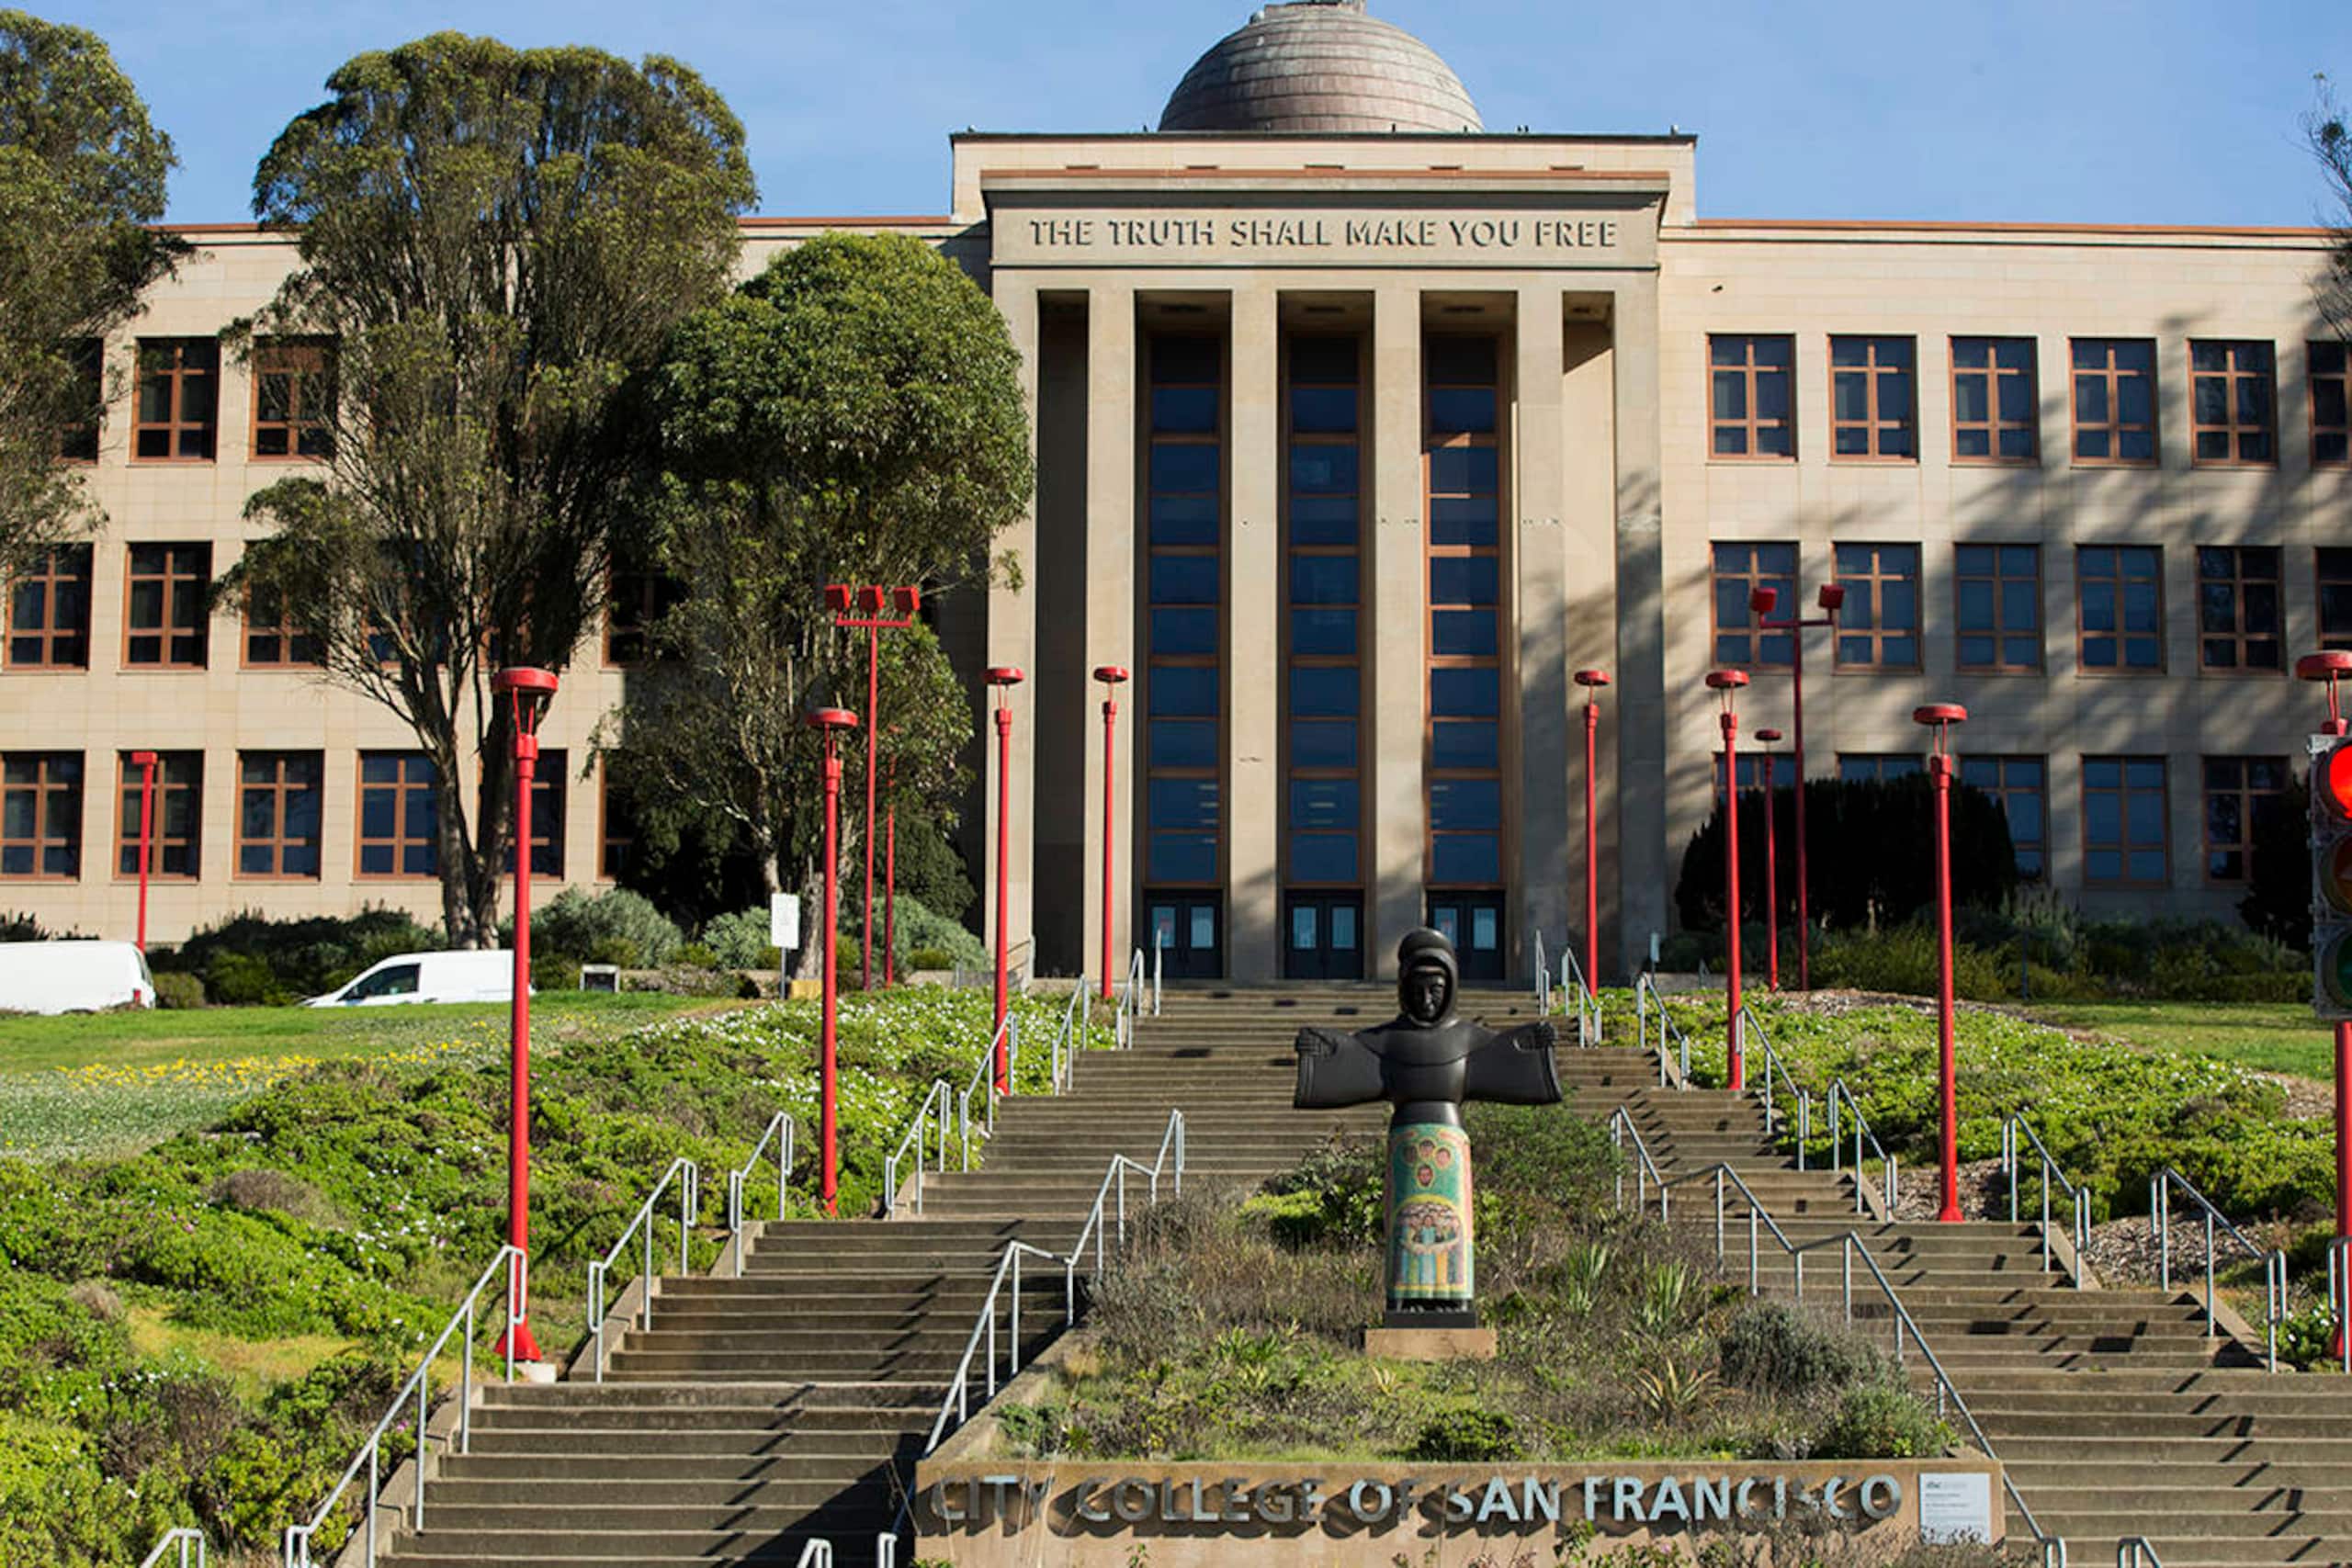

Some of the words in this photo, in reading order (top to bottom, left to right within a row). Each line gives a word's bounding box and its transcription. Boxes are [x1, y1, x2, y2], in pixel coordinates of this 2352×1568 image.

[1029, 220, 1094, 246] THE
[1107, 220, 1214, 246] TRUTH
[1230, 220, 1331, 246] SHALL
[1346, 220, 1437, 247] MAKE
[1449, 220, 1520, 247] YOU
[1534, 220, 1618, 247] FREE
[930, 1475, 1055, 1522] CITY
[1076, 1475, 1327, 1523] COLLEGE
[1349, 1477, 1425, 1523] OF
[1445, 1475, 1560, 1523] SAN
